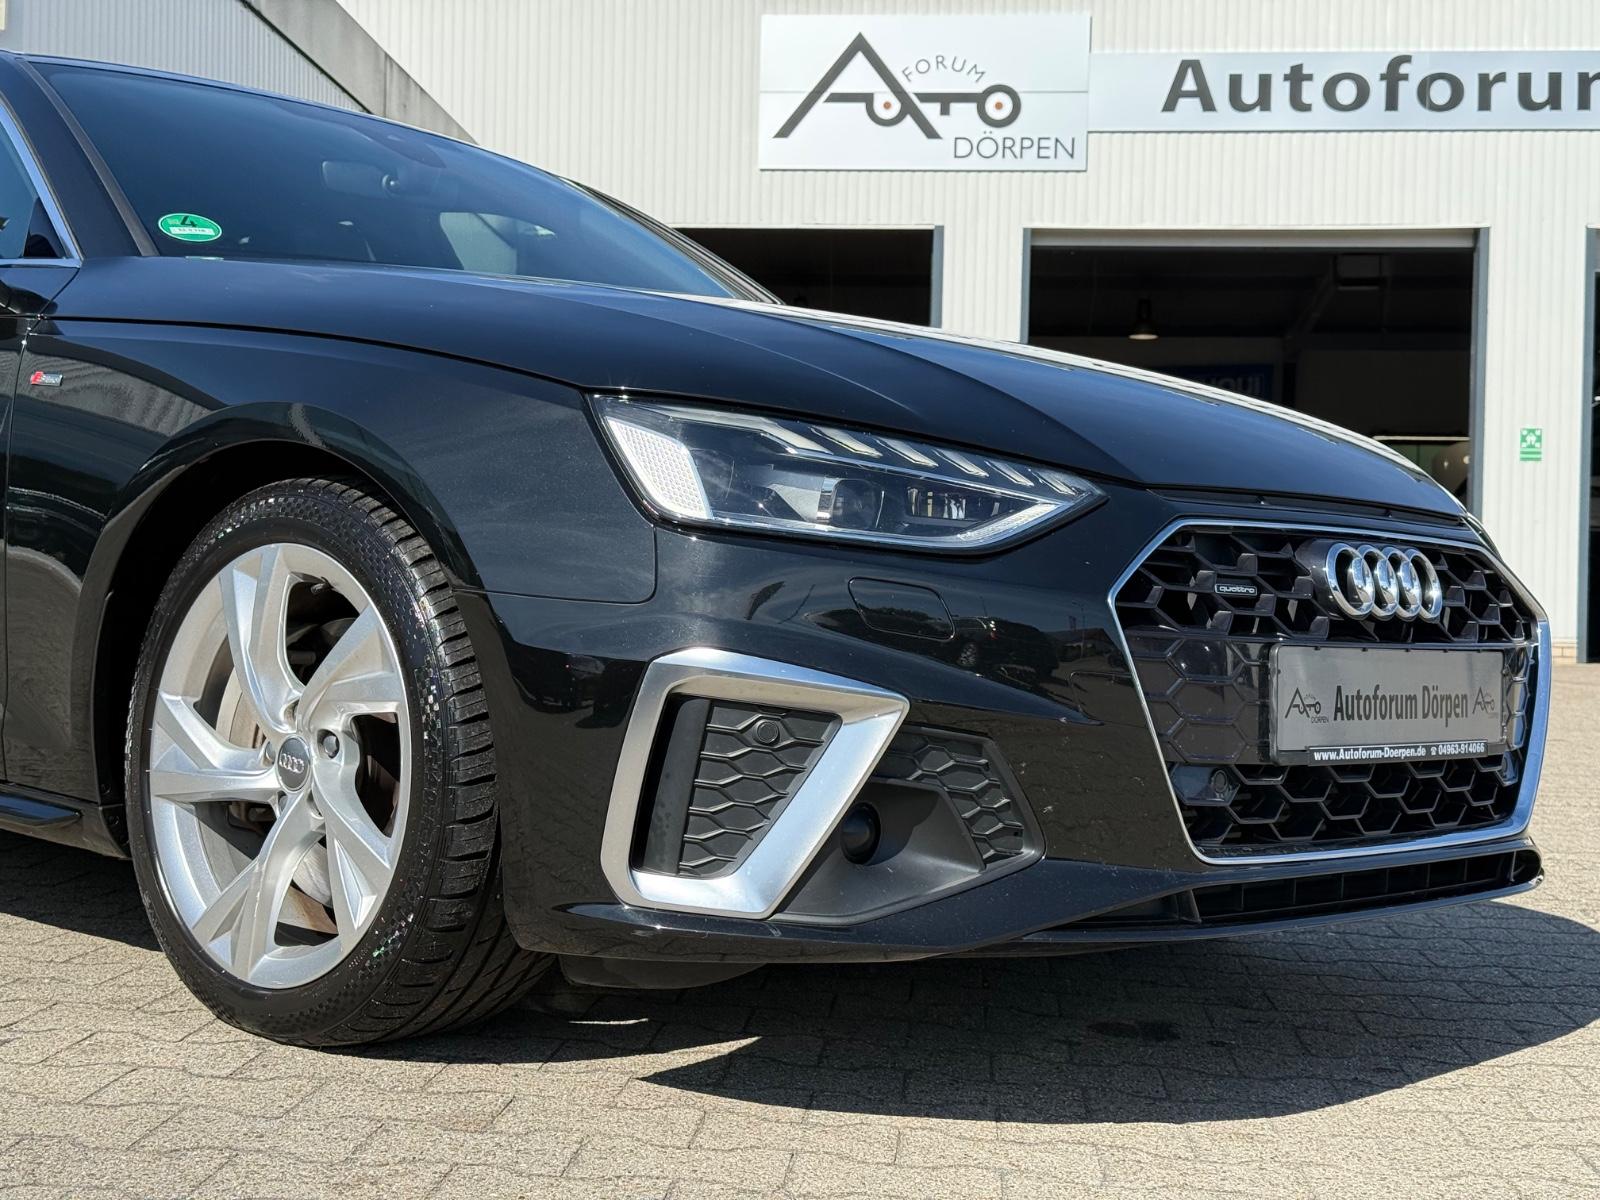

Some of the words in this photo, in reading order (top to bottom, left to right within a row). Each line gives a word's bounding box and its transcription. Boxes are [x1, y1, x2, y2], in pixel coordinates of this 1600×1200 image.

[901, 55, 986, 83] FORUM
[953, 131, 1075, 159] DÖRPEN
[1219, 586, 1254, 594] quattro
[1333, 684, 1417, 721] Autoforum
[1422, 684, 1468, 728] Dörpen
[1314, 745, 1426, 761] www.Autoforum-Doerpen.de
[1438, 742, 1485, 756] 04963-914066
